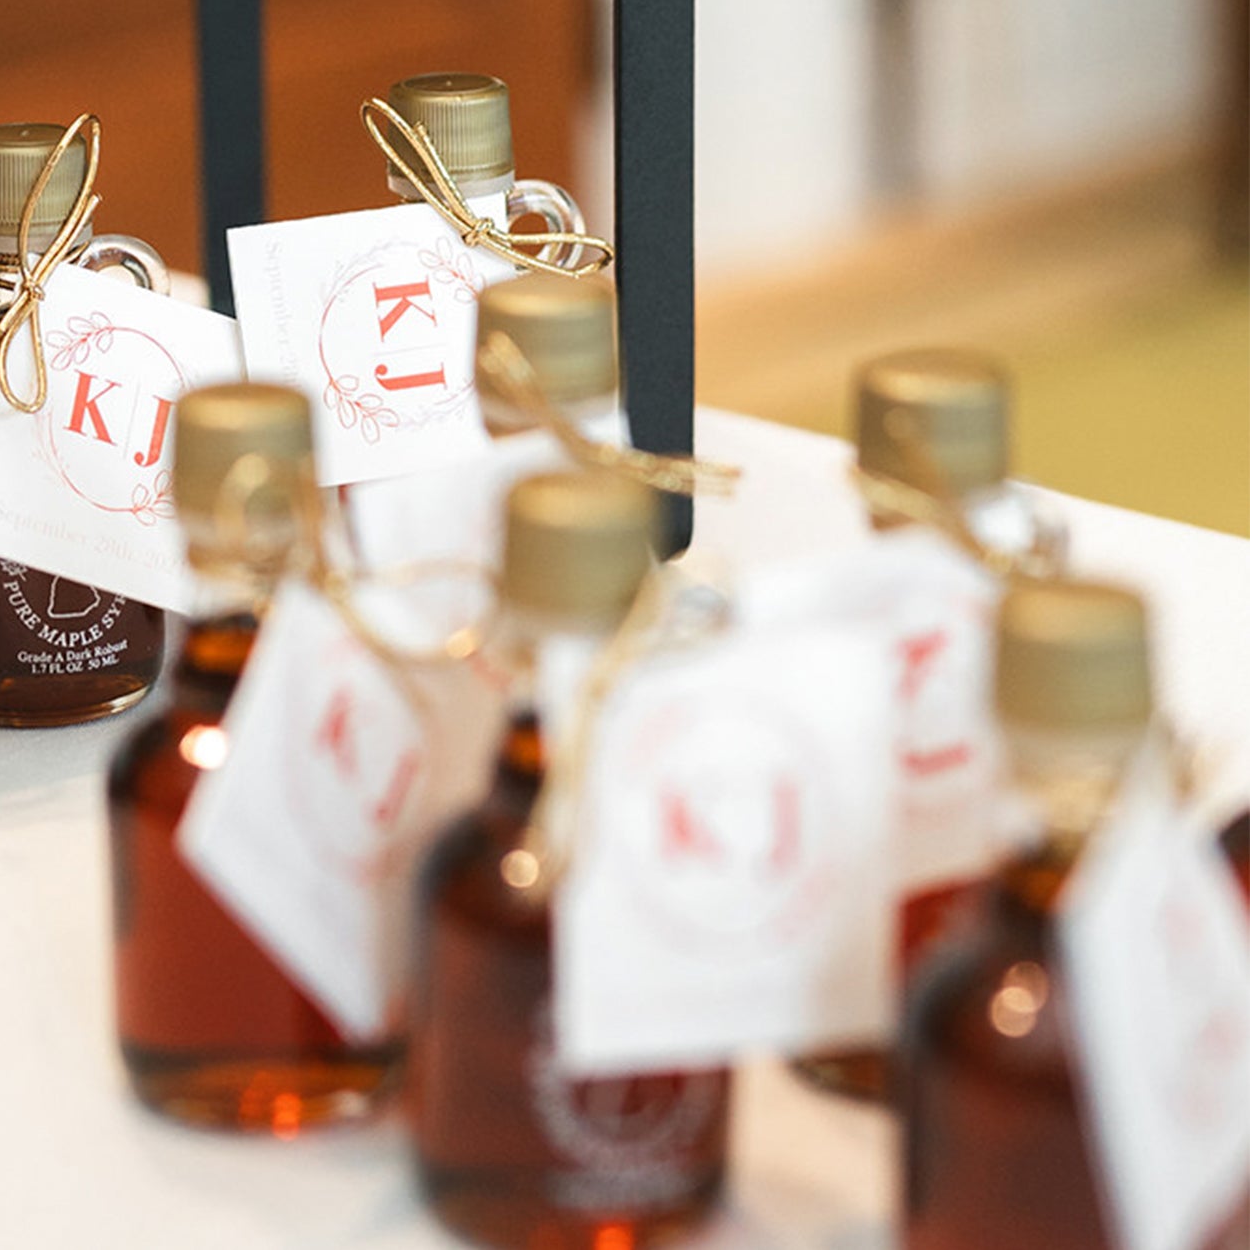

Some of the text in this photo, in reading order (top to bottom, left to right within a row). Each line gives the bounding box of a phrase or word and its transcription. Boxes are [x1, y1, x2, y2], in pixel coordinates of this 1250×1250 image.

[372, 274, 448, 392] K J
[63, 368, 175, 467] K J
[3, 581, 41, 630] PURE
[38, 625, 103, 647] MAPLE
[17, 639, 128, 663] Grade A Dark Robust
[31, 654, 120, 674] 1.7 FL OZ 50 ML
